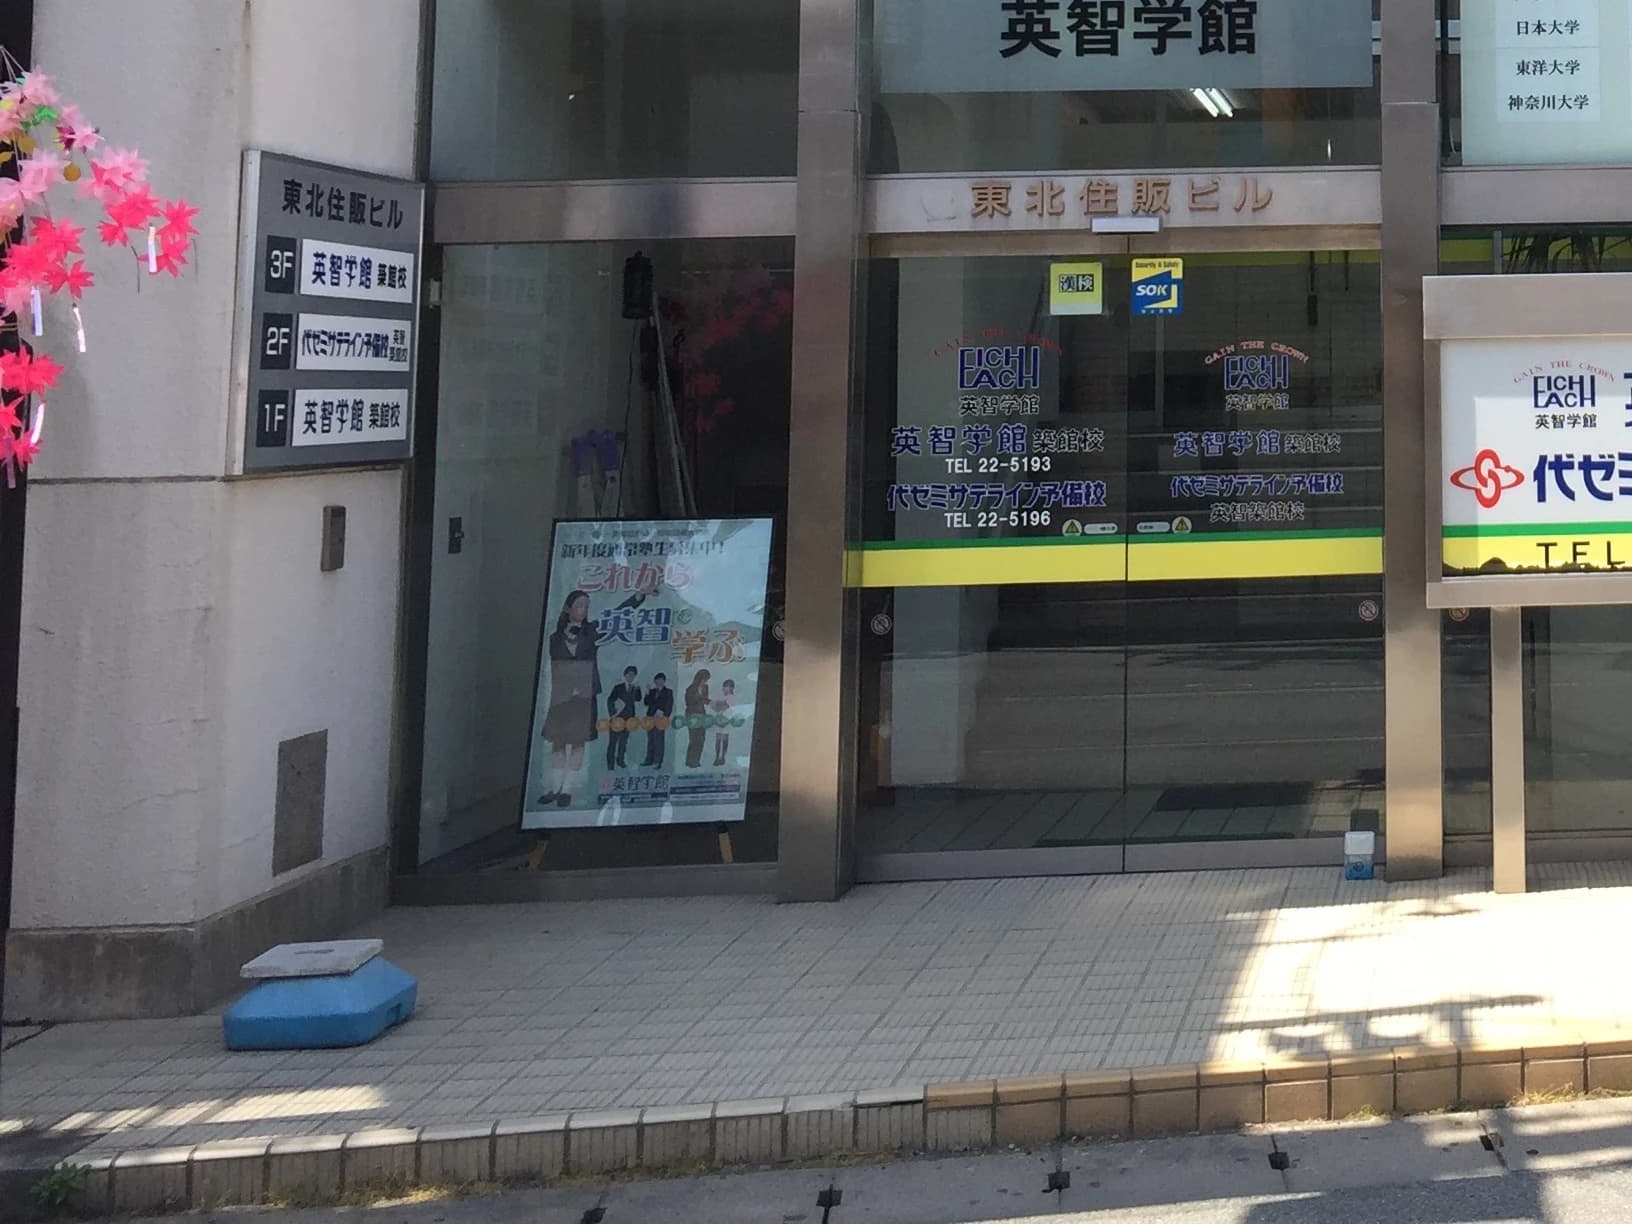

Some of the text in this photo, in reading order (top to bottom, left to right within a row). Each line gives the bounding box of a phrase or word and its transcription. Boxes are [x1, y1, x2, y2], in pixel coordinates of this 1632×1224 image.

[1516, 20, 1580, 36] 日本大学
[1516, 60, 1580, 76] 東洋大学
[1508, 95, 1589, 111] 神奈川大学
[282, 178, 403, 229] 東北住販ビル
[970, 178, 1274, 219] 東北住販ビル
[270, 249, 294, 279] 3F
[311, 251, 407, 290] 英智学館 築館校
[266, 327, 290, 356] 2F
[1240, 340, 1265, 350] THE
[264, 403, 286, 433] 1F
[302, 398, 400, 434] 英智学館 築館校
[959, 394, 1040, 417] 英智学館
[1535, 412, 1597, 430] 英智学館
[891, 422, 1105, 457] 英智学館 築館校
[1173, 429, 1342, 458] 英智学館 築館校
[945, 456, 1051, 473] TEL 22-5193
[886, 480, 1107, 511] 代ゼミサテライン予備校
[1170, 472, 1345, 499] 代ゼミサテライン予備校
[944, 510, 1051, 528] TEL 22-5196
[1209, 500, 1305, 523] 英智築館校
